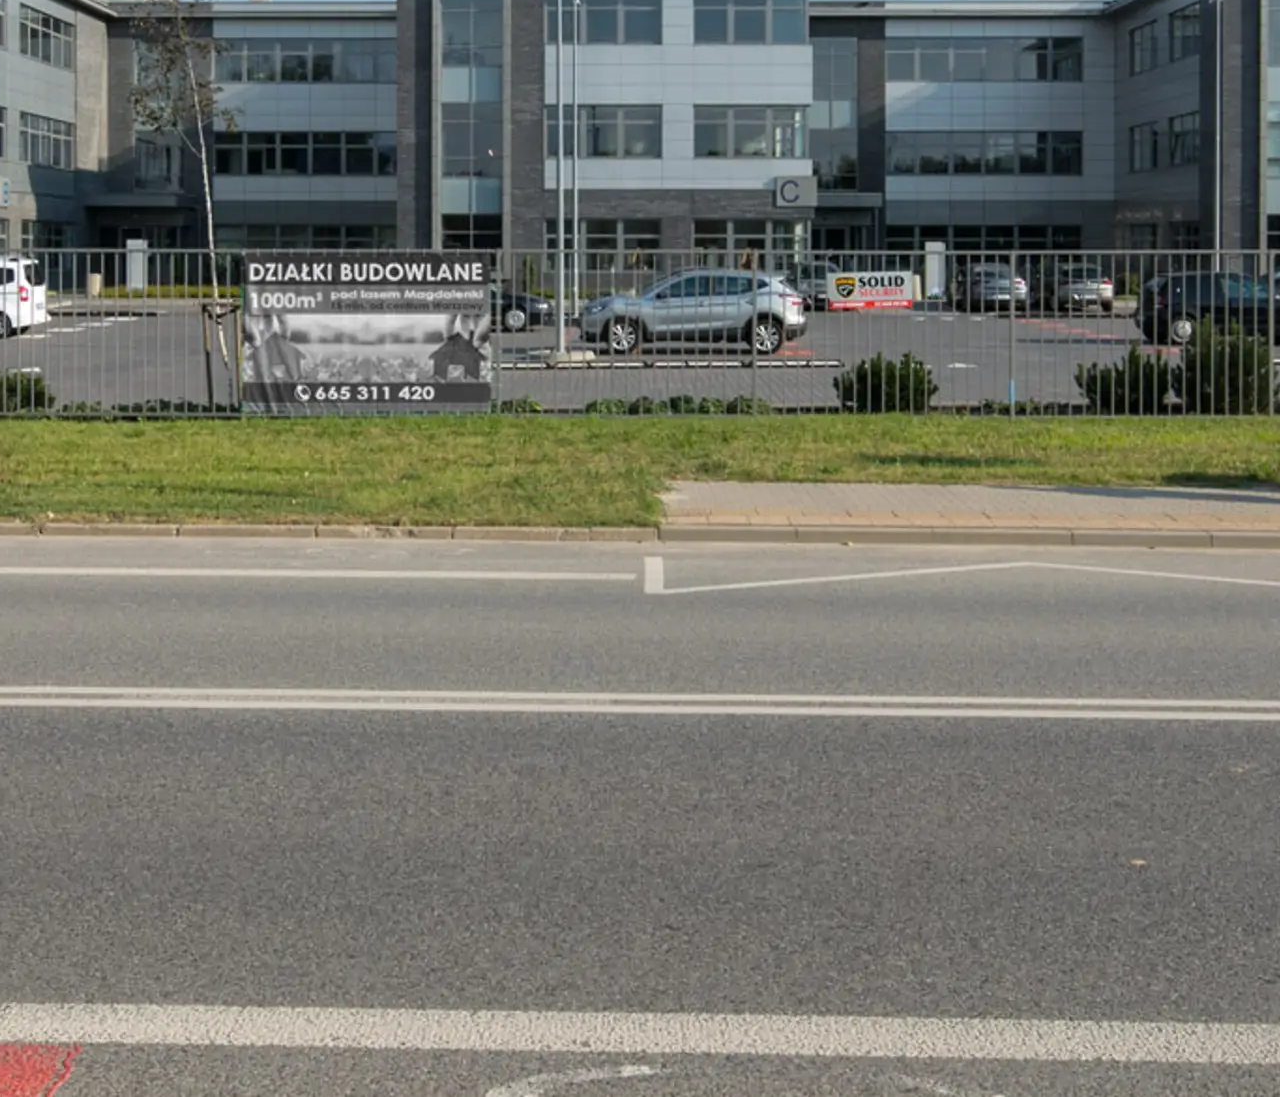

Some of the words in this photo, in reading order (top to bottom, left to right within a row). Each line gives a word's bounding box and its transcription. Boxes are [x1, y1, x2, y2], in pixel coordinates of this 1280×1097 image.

[780, 179, 800, 203] C
[248, 262, 333, 282] DZIAŁKI
[339, 262, 484, 282] BUDOWLANE
[858, 275, 906, 288] SOLID
[330, 289, 357, 301] pod
[404, 289, 485, 301] Magdalenki
[315, 386, 352, 400] 665
[357, 386, 391, 400] 311
[398, 386, 436, 400] 420
